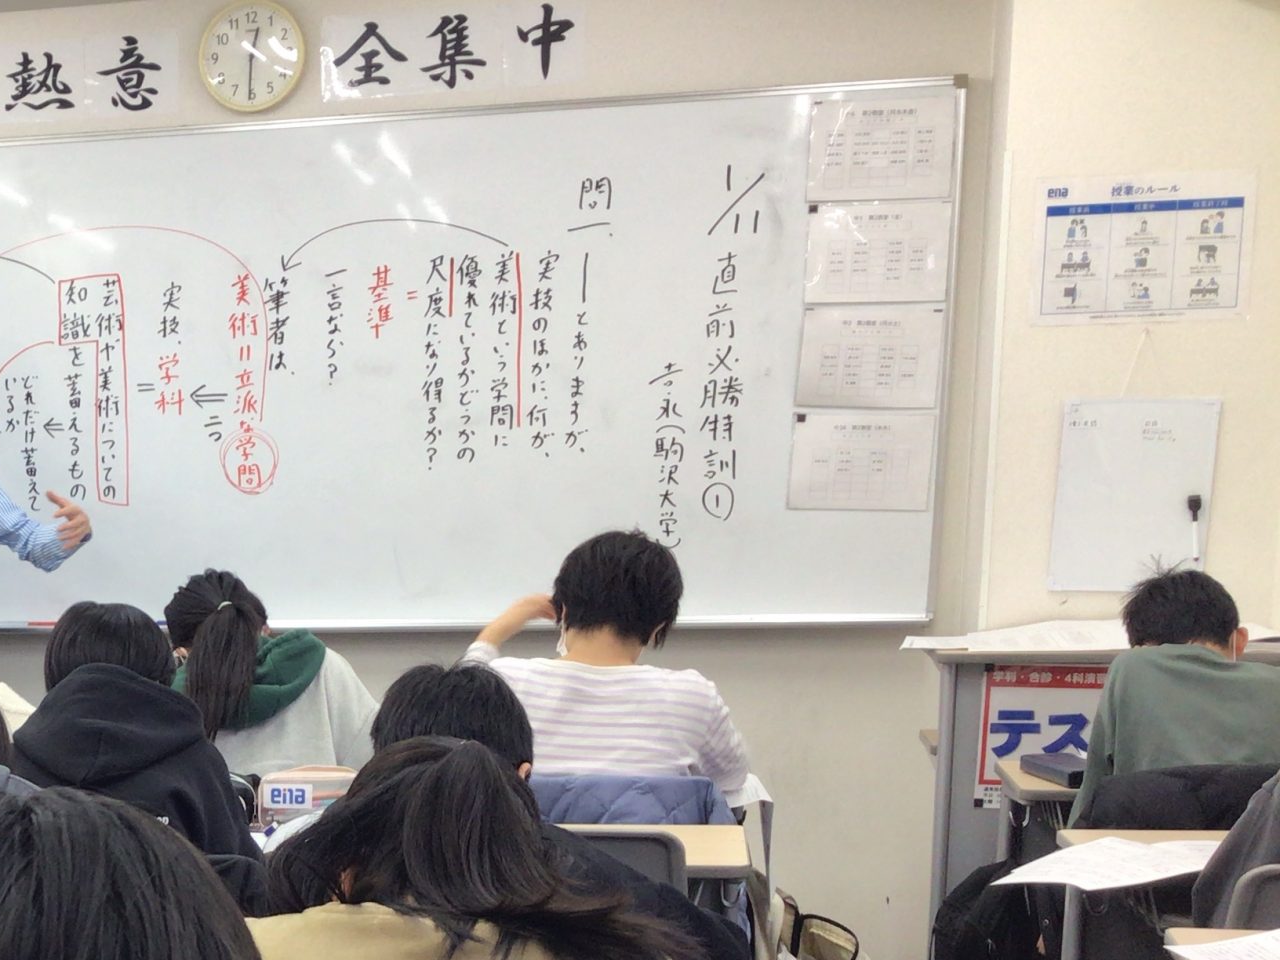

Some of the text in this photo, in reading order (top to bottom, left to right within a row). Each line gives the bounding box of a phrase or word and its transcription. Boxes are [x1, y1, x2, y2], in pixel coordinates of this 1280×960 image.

[229, 18, 239, 30] 11
[245, 11, 258, 24] 12
[268, 15, 274, 27] 1
[217, 33, 229, 45] 10
[281, 28, 288, 40] 2
[333, 3, 575, 89] 全集中
[211, 53, 219, 65] 9
[232, 84, 239, 96] 7
[267, 82, 274, 94] 5
[1048, 187, 1068, 198] ena
[1111, 184, 1180, 197] 授業のルール
[367, 264, 394, 339] 基準
[60, 279, 90, 501] 知識を蓄えるもの
[94, 278, 122, 499] 芸術や美術についての
[4, 377, 21, 433] いるか
[20, 375, 42, 513] どれだけ蓄えて
[989, 709, 1090, 758] テス
[270, 788, 306, 805] ena
